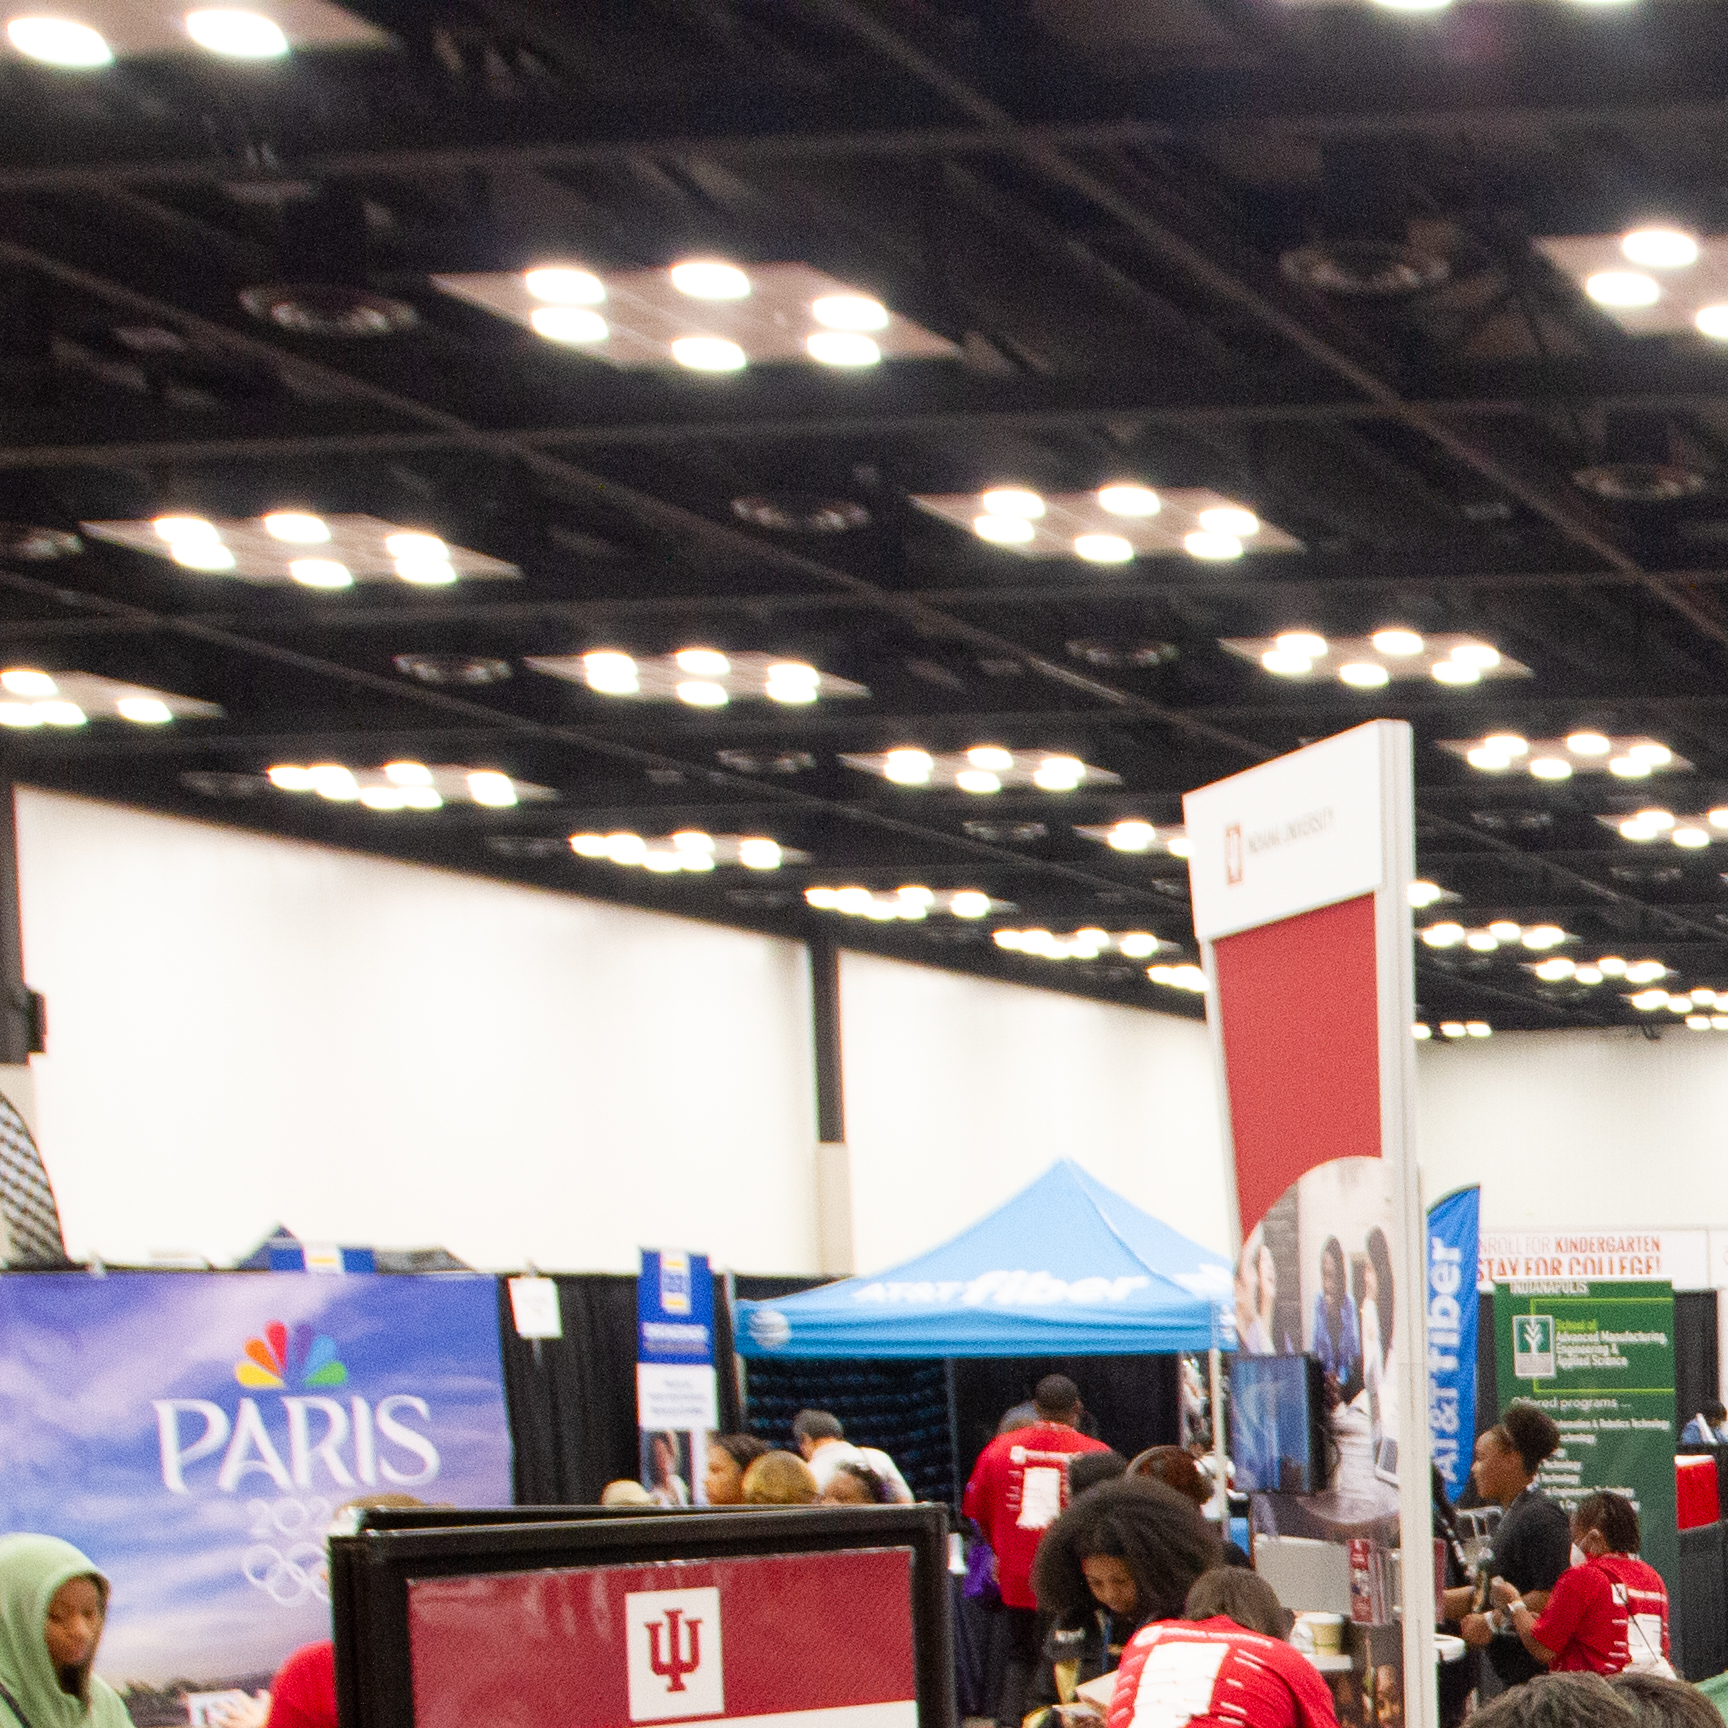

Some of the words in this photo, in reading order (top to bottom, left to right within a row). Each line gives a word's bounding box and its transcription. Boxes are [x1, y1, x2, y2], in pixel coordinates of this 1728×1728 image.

[1478, 1257, 1519, 1282] STAY
[1568, 1256, 1662, 1277] COLLEGE!
[1555, 1235, 1662, 1253] KINDERGARTEN
[151, 1394, 442, 1495] PARIS
[1428, 1377, 1460, 1484] AT&T
